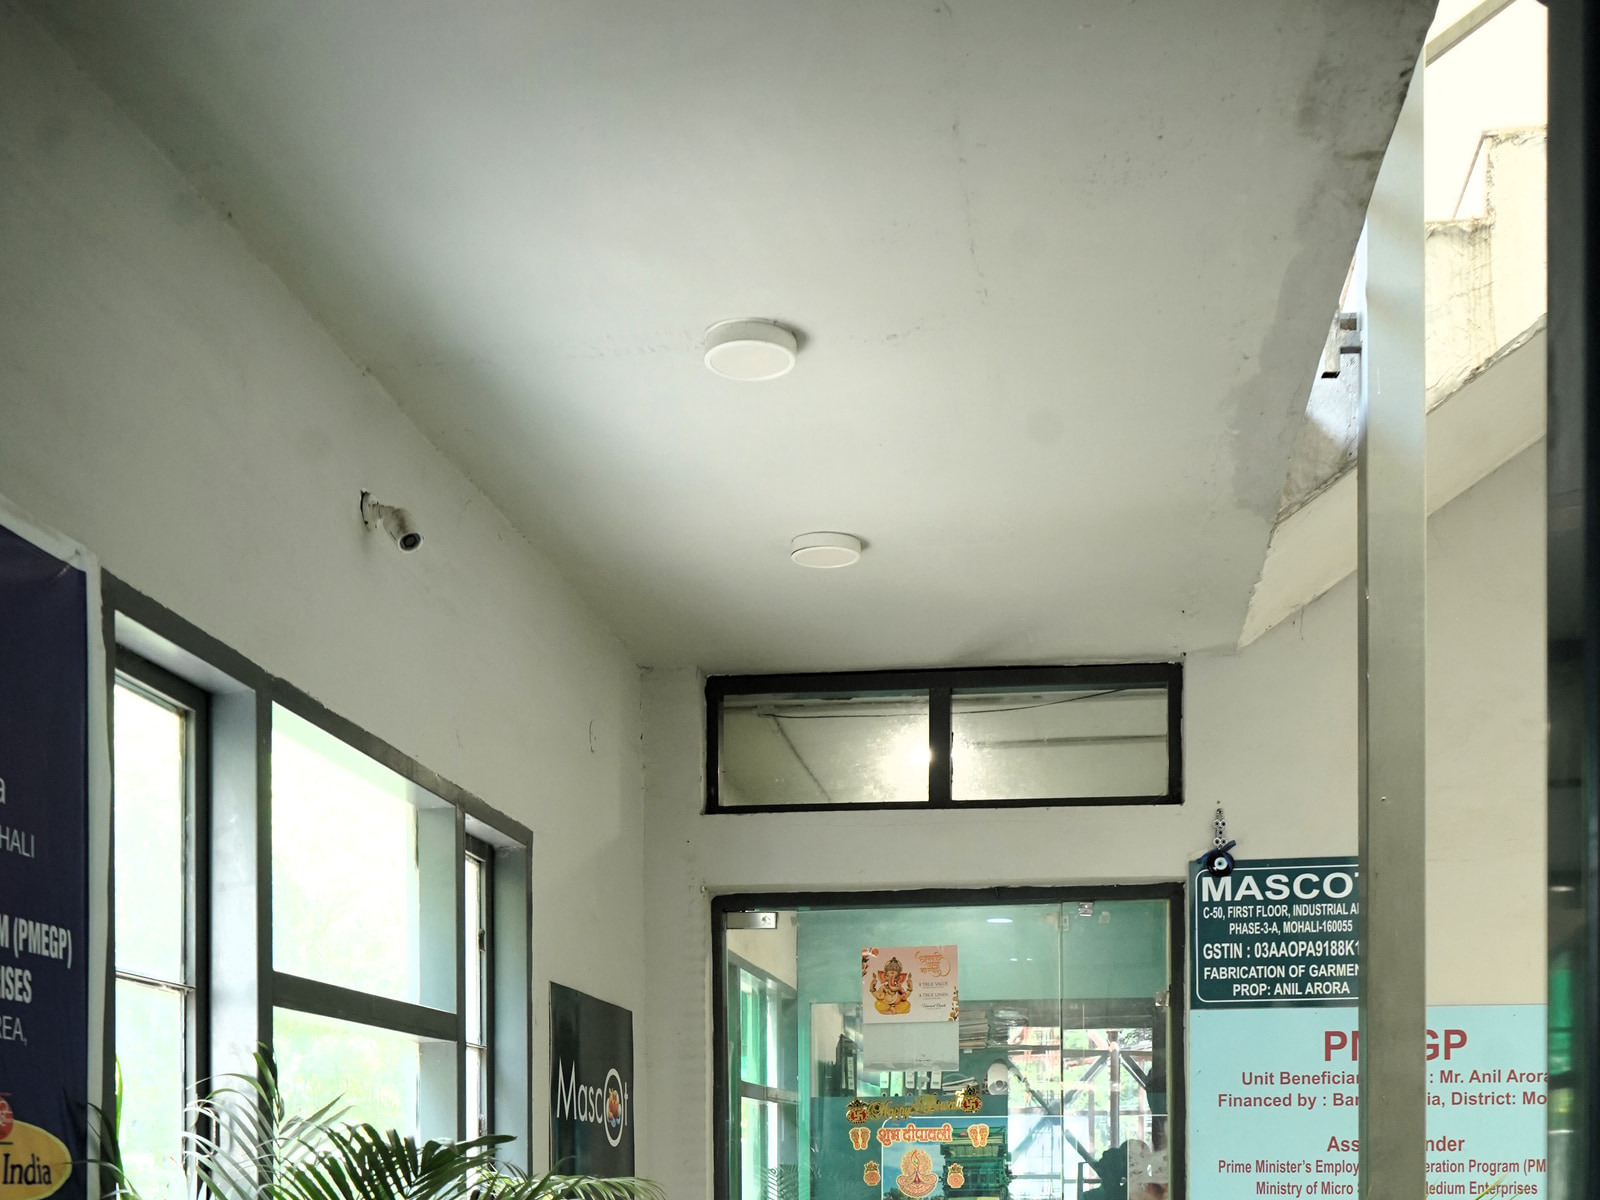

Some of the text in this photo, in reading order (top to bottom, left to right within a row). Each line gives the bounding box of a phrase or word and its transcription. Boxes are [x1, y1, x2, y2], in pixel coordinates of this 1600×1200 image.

[0, 825, 34, 858] HALI
[1202, 872, 1359, 902] MASCO
[1203, 907, 1226, 920] C-50,
[1228, 905, 1253, 918] FIRST
[1256, 905, 1290, 918] FLOOR,
[1293, 903, 1349, 916] INDUSTRIAL
[1229, 920, 1353, 935] PHASE-3-A, MOHALI-160055
[13, 916, 73, 969] (PMEGP)
[1203, 943, 1242, 959] GSTIN
[1254, 939, 1359, 958] 03AAOPA9188K1
[1203, 966, 1286, 980] FABRICATION
[1289, 965, 1306, 978] OF
[1232, 981, 1350, 996] PROP: ANIL ARORA
[1242, 1071, 1275, 1085] Unit
[1280, 1071, 1359, 1085] Beneficia
[1440, 1070, 1464, 1083] Mr.
[1469, 1069, 1501, 1083] Anil
[1218, 1093, 1292, 1107] Financed
[1297, 1093, 1317, 1110] by
[1427, 1092, 1445, 1108] ia,
[1451, 1092, 1516, 1106] District:
[1523, 1091, 1548, 1105] Mo
[878, 1126, 900, 1146] शुभ
[1426, 1136, 1465, 1152] nder
[3, 1153, 52, 1185] India
[1218, 1160, 1252, 1173] Prime
[1315, 1160, 1359, 1176] Employ
[1425, 1160, 1465, 1173] eration
[1469, 1159, 1520, 1176] Program
[1523, 1159, 1547, 1176] (PM
[1256, 1181, 1303, 1198] Ministry
[1306, 1181, 1318, 1194] of
[1321, 1181, 1354, 1194] Micro
[1426, 1181, 1465, 1195] edium
[1469, 1181, 1538, 1198] Enterprises
